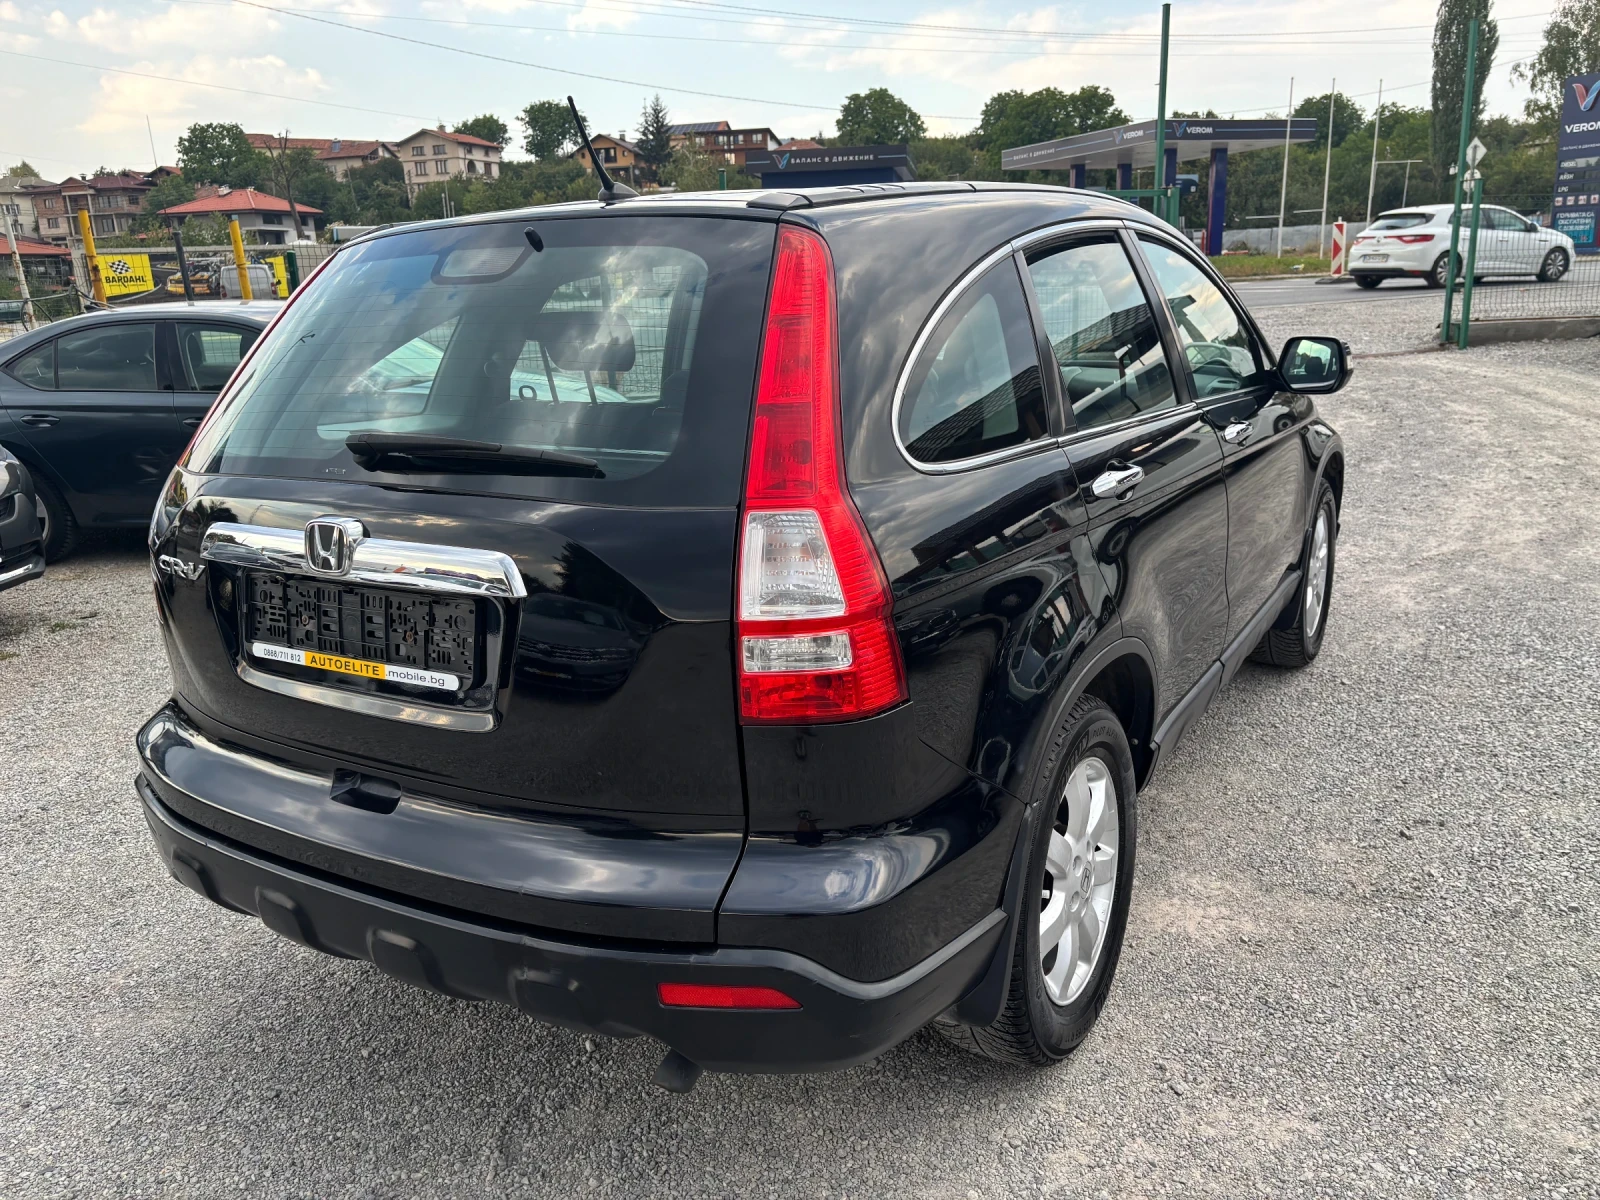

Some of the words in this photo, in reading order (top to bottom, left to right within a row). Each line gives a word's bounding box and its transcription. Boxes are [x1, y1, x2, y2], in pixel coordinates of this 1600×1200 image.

[1122, 129, 1144, 140] VEROM
[1186, 126, 1213, 134] VEROM
[832, 154, 875, 163] ДВИЖЕНИЕ
[105, 275, 147, 286] BARDAHL
[158, 554, 206, 581] CR-V
[263, 648, 289, 662] 0888/711
[290, 652, 302, 663] 812
[310, 655, 380, 676] AUTOELITE
[385, 669, 445, 687] .mobile.bg
